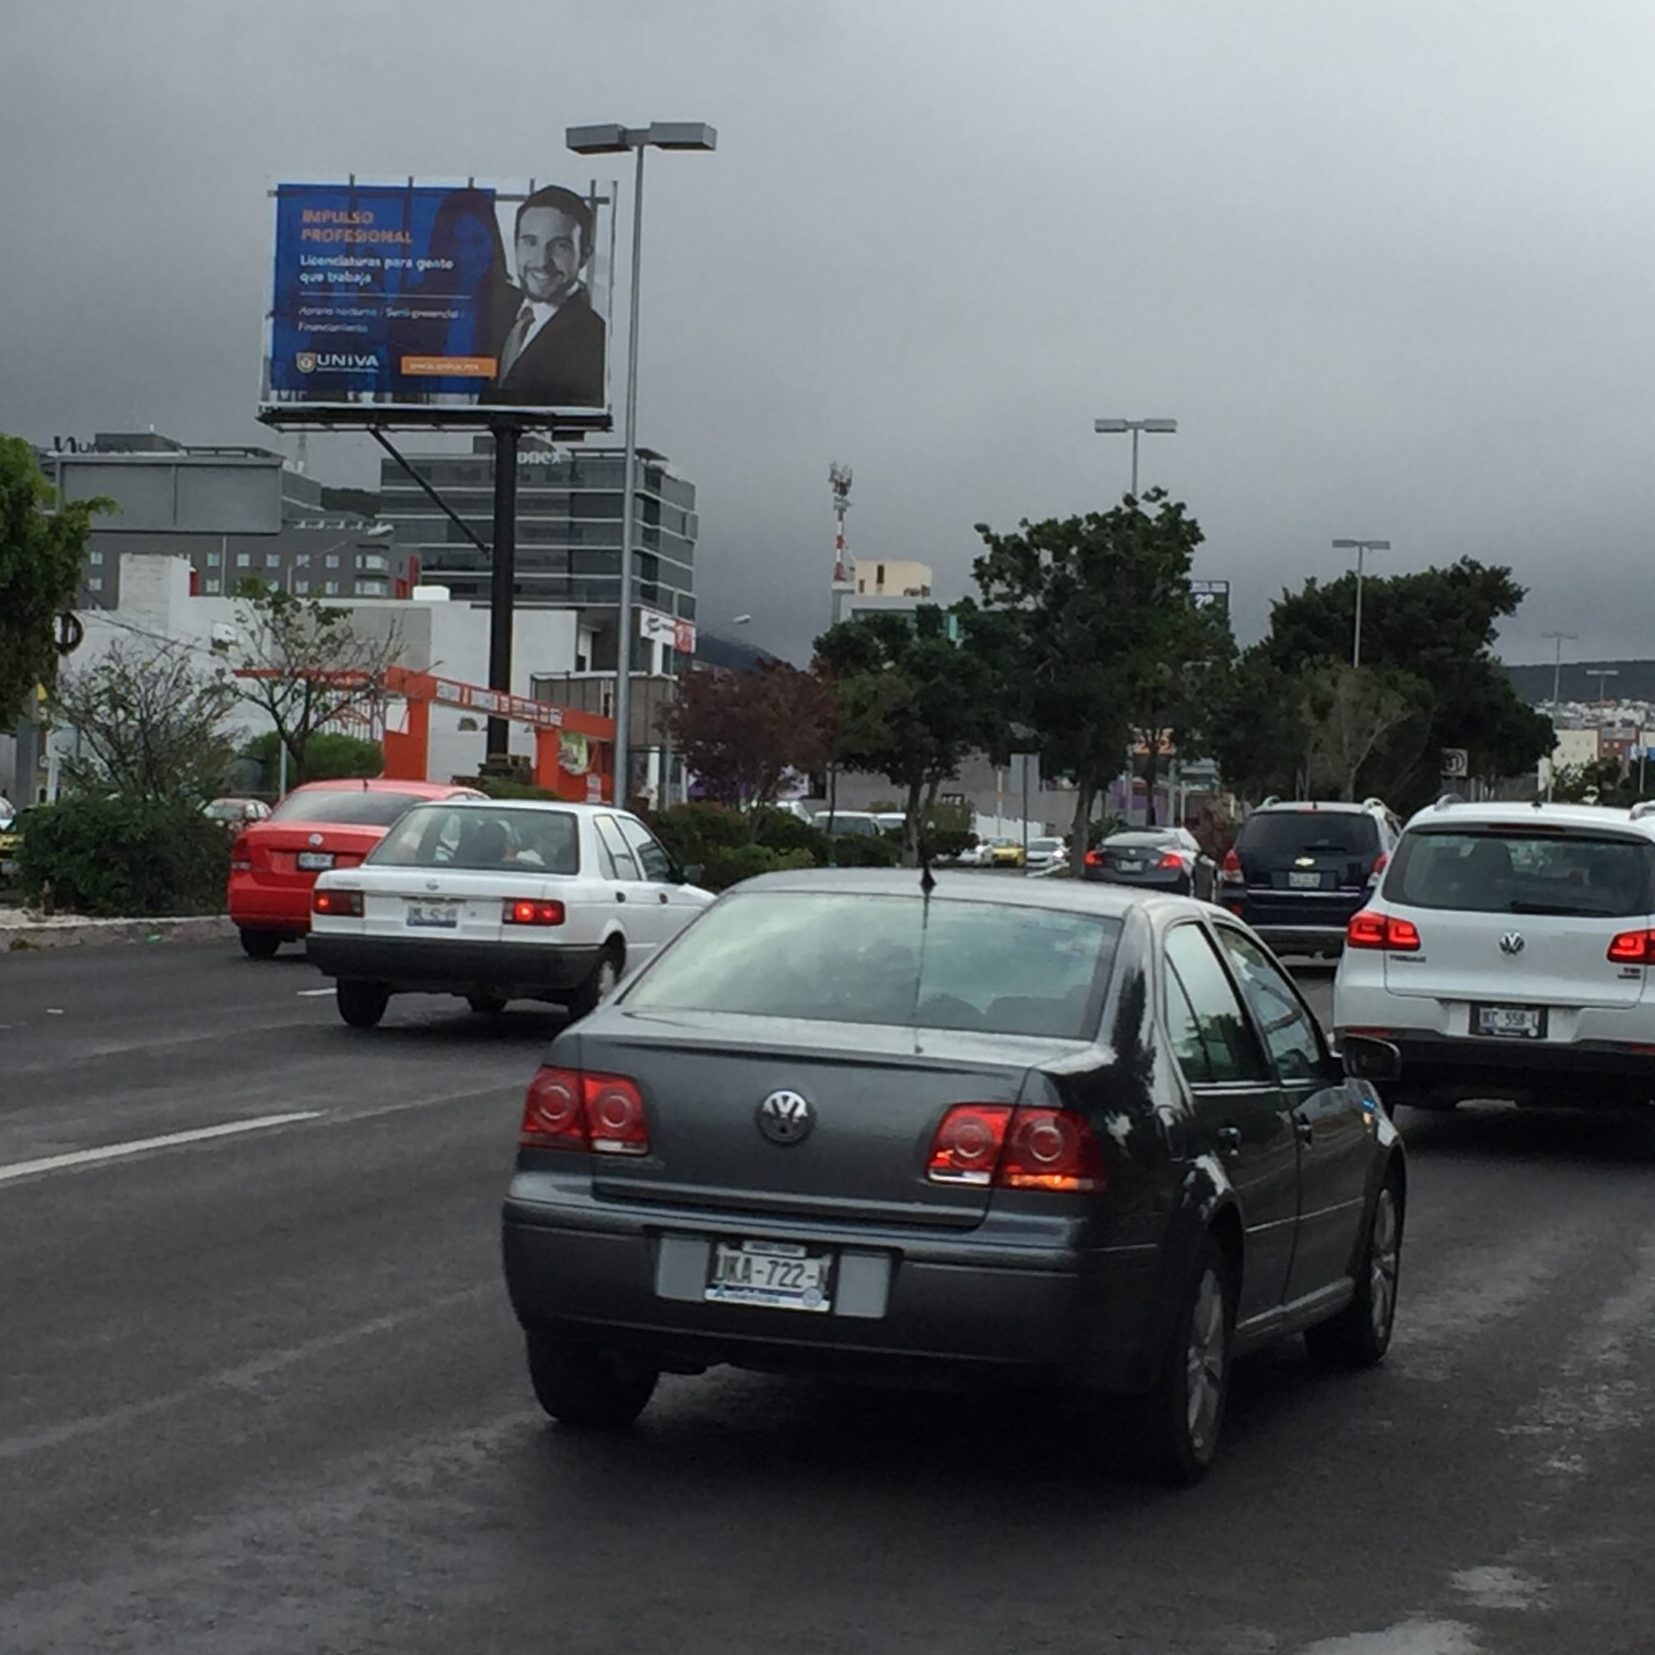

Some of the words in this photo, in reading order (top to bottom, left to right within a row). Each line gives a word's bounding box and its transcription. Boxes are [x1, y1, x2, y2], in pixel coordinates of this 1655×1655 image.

[302, 209, 374, 225] IMPULSO
[301, 228, 412, 244] PROFESIONAL
[300, 254, 381, 268] Licenciaturas
[384, 257, 413, 270] para
[300, 274, 323, 285] que
[327, 270, 372, 286] trabaja
[317, 353, 379, 368] UNIVA
